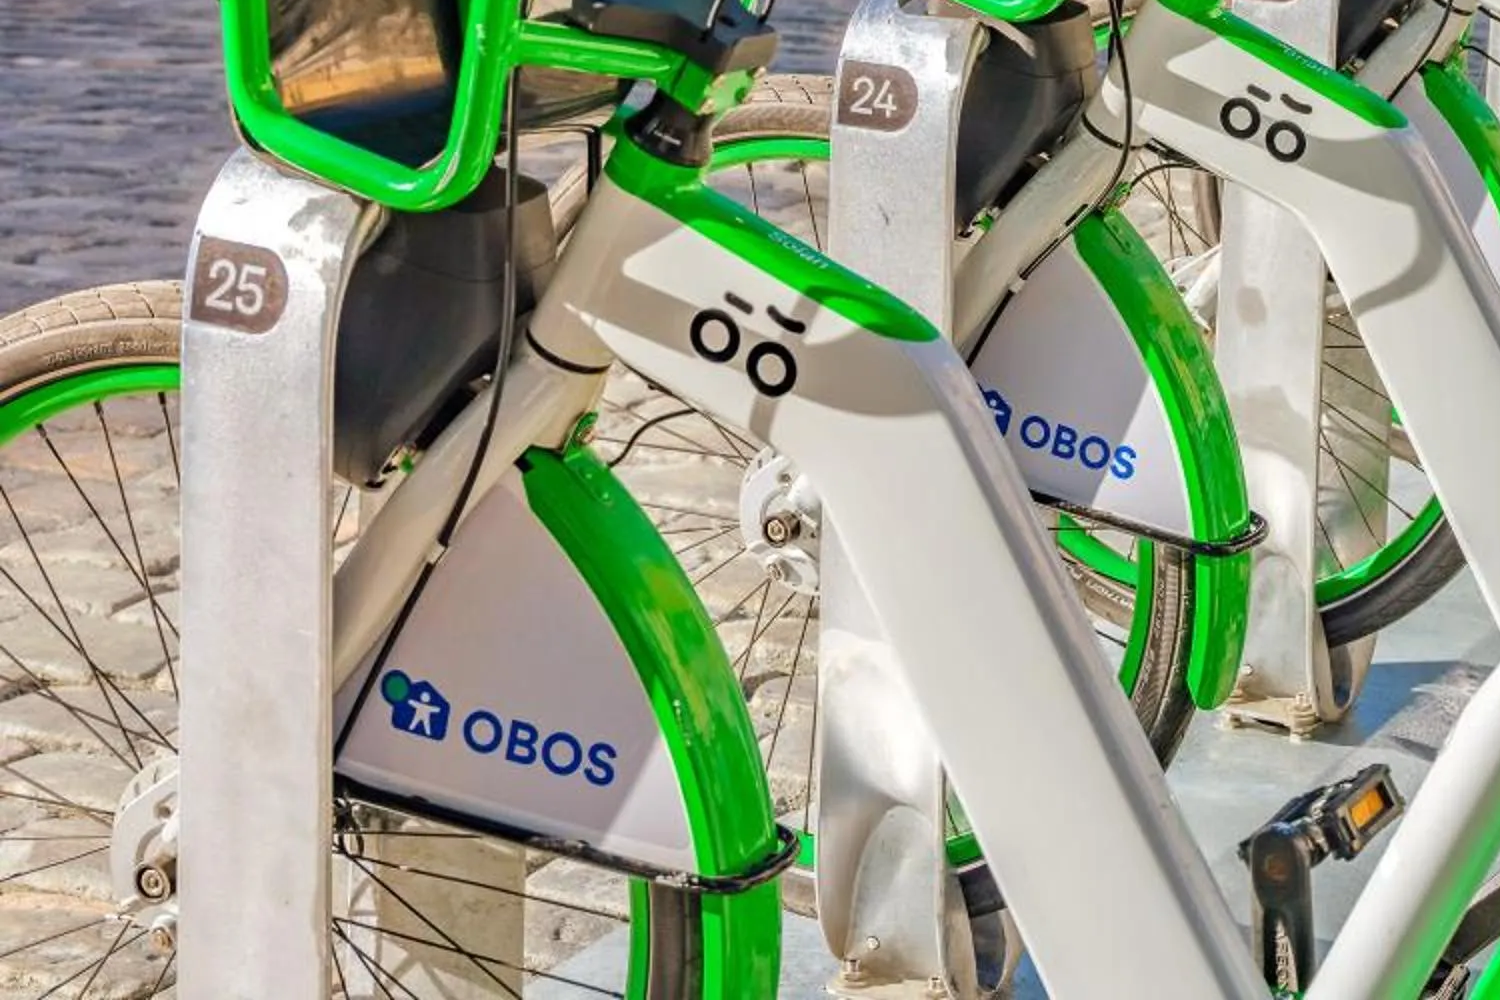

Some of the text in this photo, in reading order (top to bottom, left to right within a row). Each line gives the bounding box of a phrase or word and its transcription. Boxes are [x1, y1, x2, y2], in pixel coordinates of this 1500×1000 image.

[850, 75, 898, 119] 24
[205, 258, 267, 316] 25
[1020, 415, 1137, 479] OBOS
[463, 710, 617, 786] OBOS
